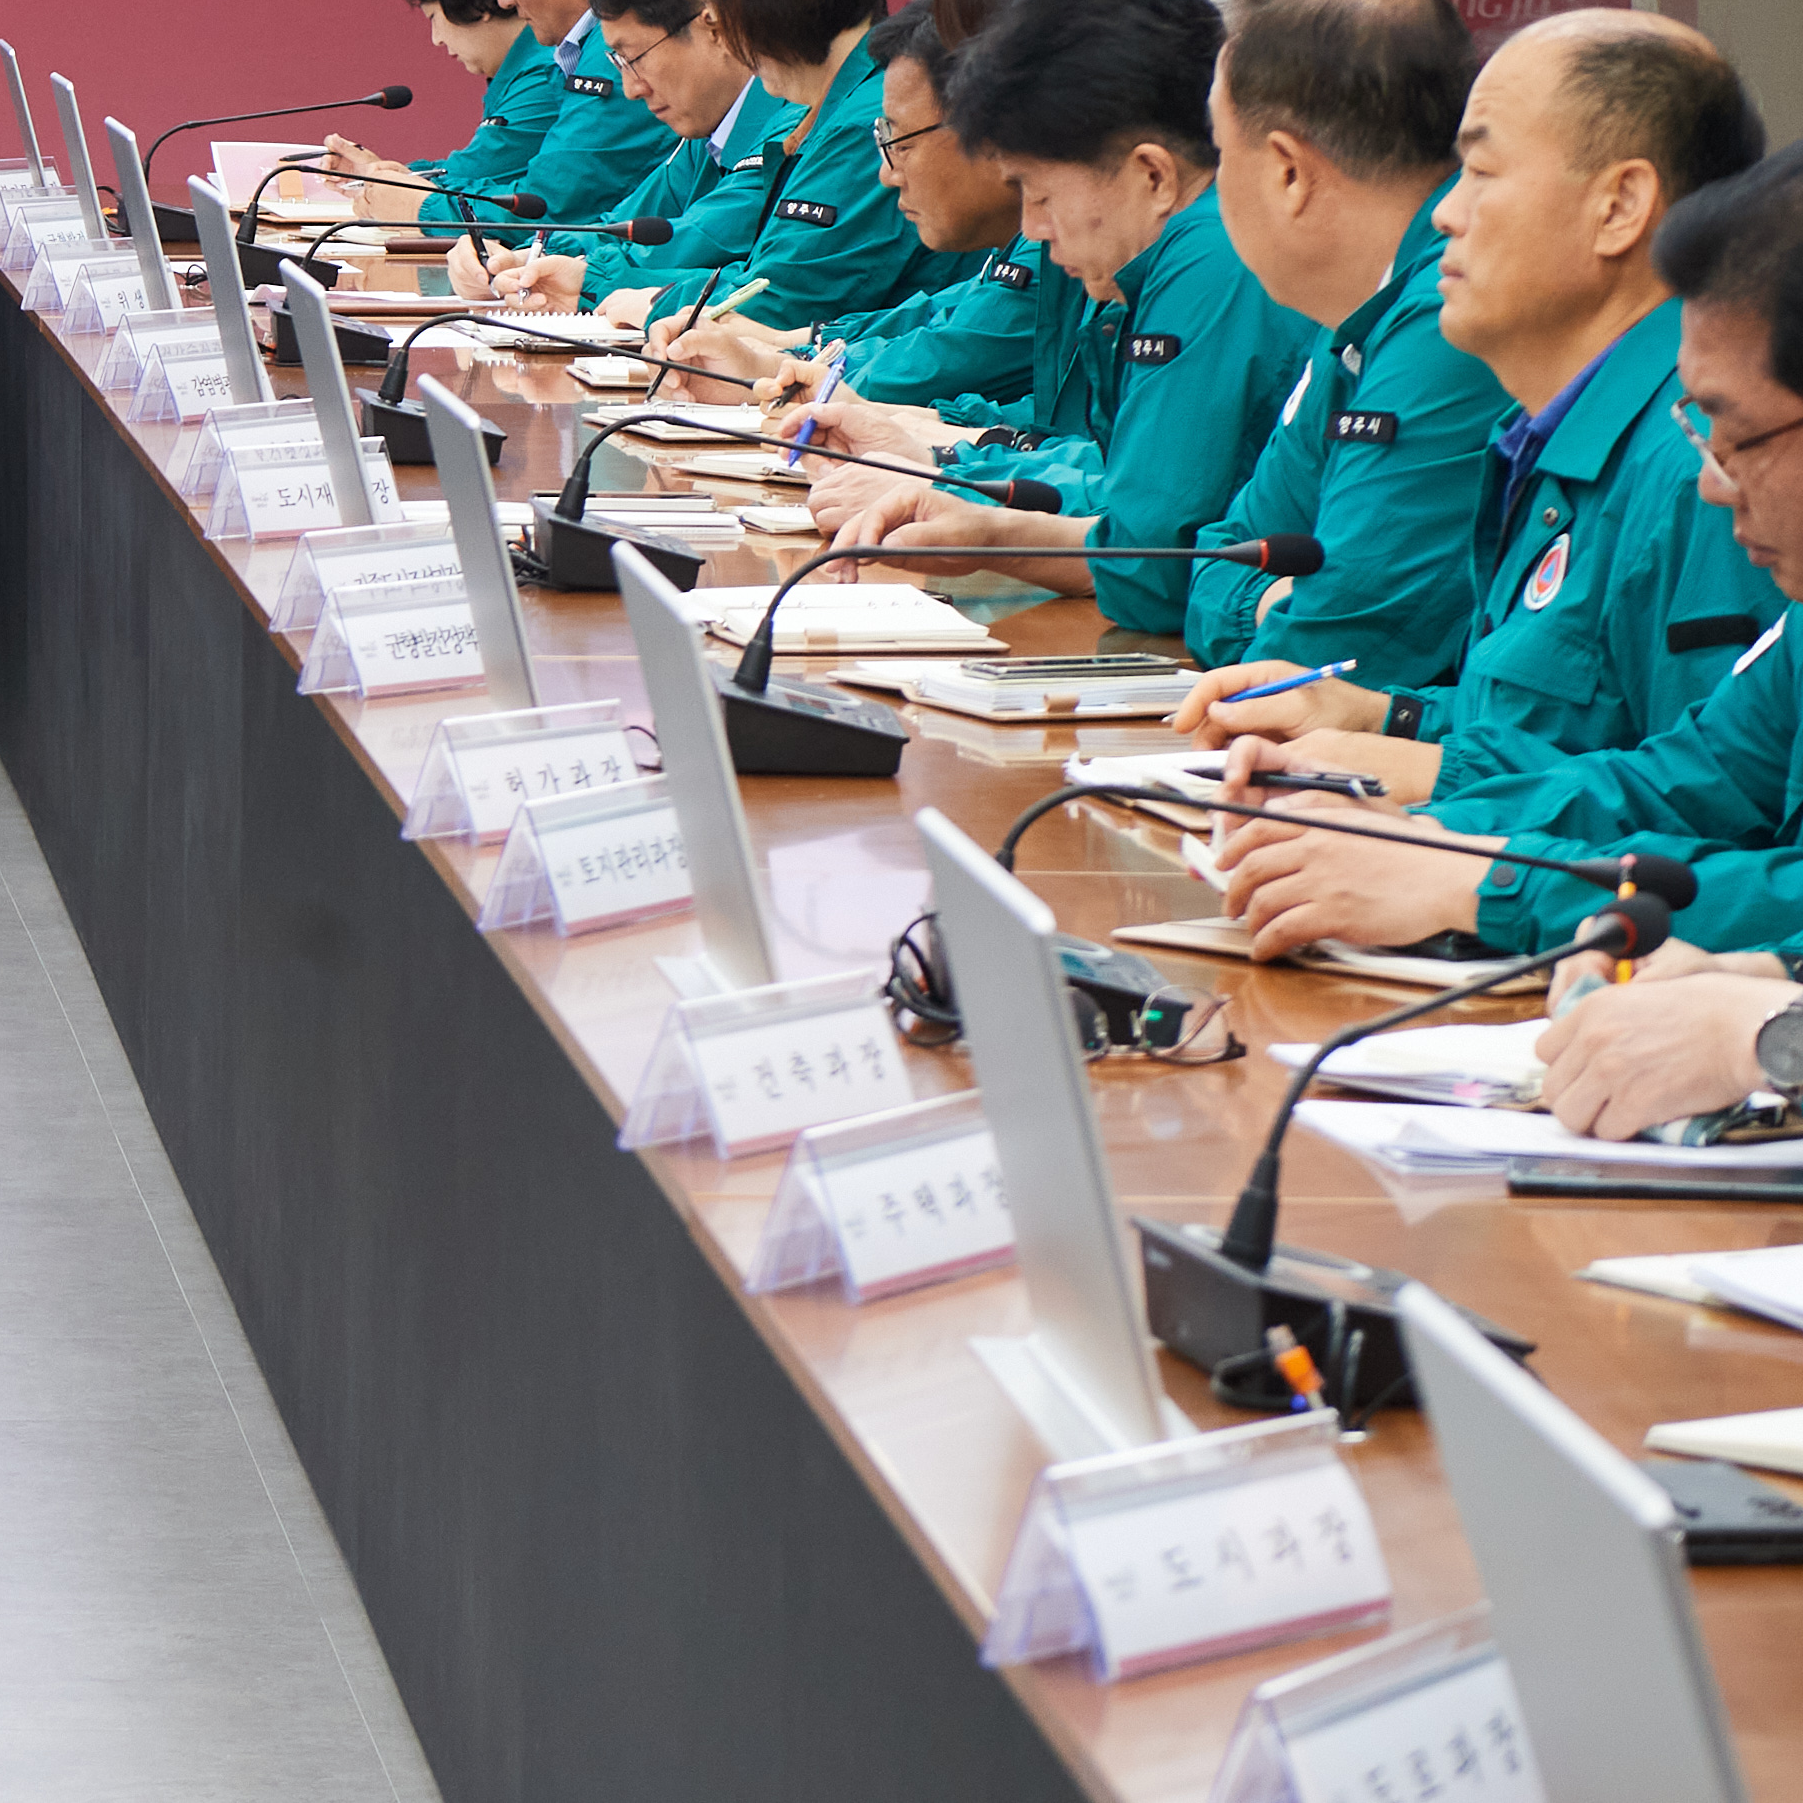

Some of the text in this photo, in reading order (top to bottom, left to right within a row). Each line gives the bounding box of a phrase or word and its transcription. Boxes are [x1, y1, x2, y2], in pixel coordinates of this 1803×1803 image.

[573, 78, 604, 93] 양주시
[786, 201, 824, 219] 양주시
[1131, 338, 1164, 357] 양주시
[1337, 415, 1382, 435] 양주시
